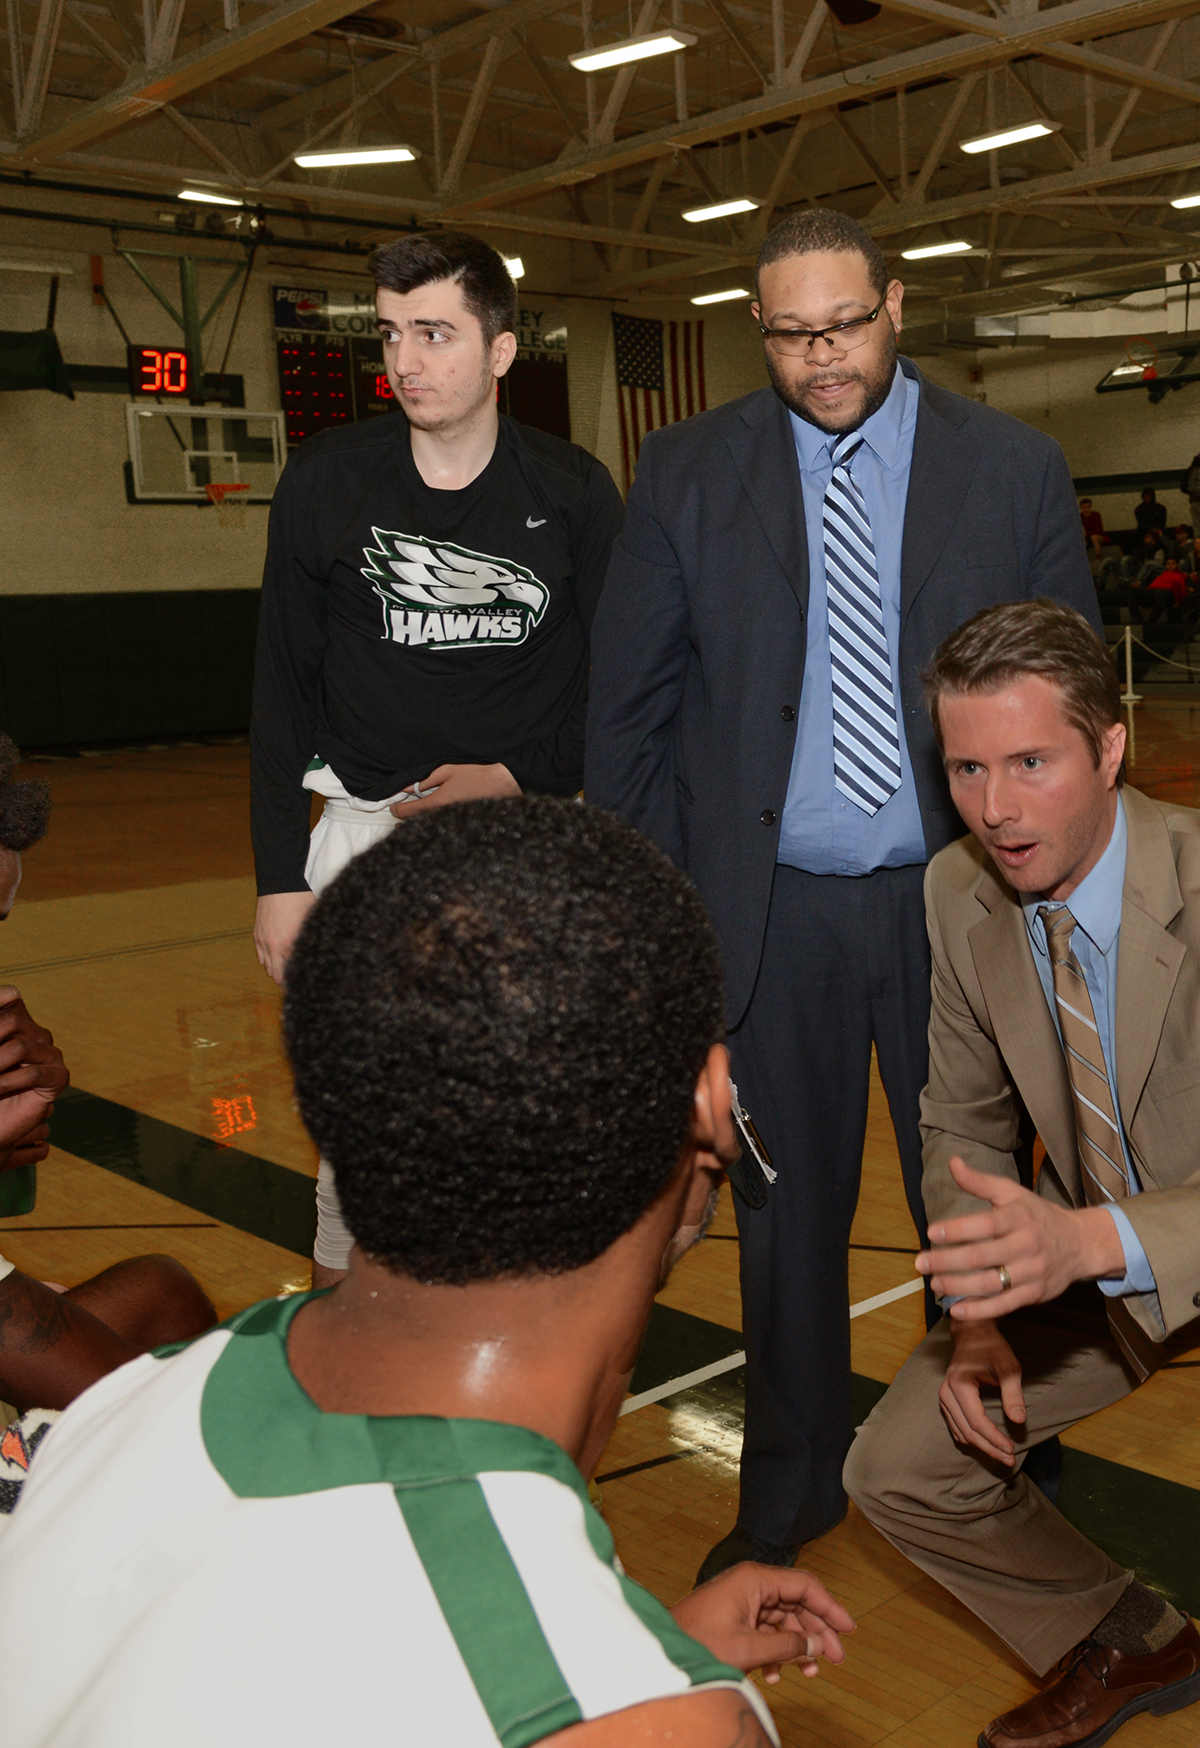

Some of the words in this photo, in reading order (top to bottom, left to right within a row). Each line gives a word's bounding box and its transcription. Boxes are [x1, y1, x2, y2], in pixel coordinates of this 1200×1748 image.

[276, 289, 325, 306] PEPSI
[141, 350, 187, 393] 30
[467, 608, 523, 616] VALLEY
[390, 609, 522, 646] HAWKS
